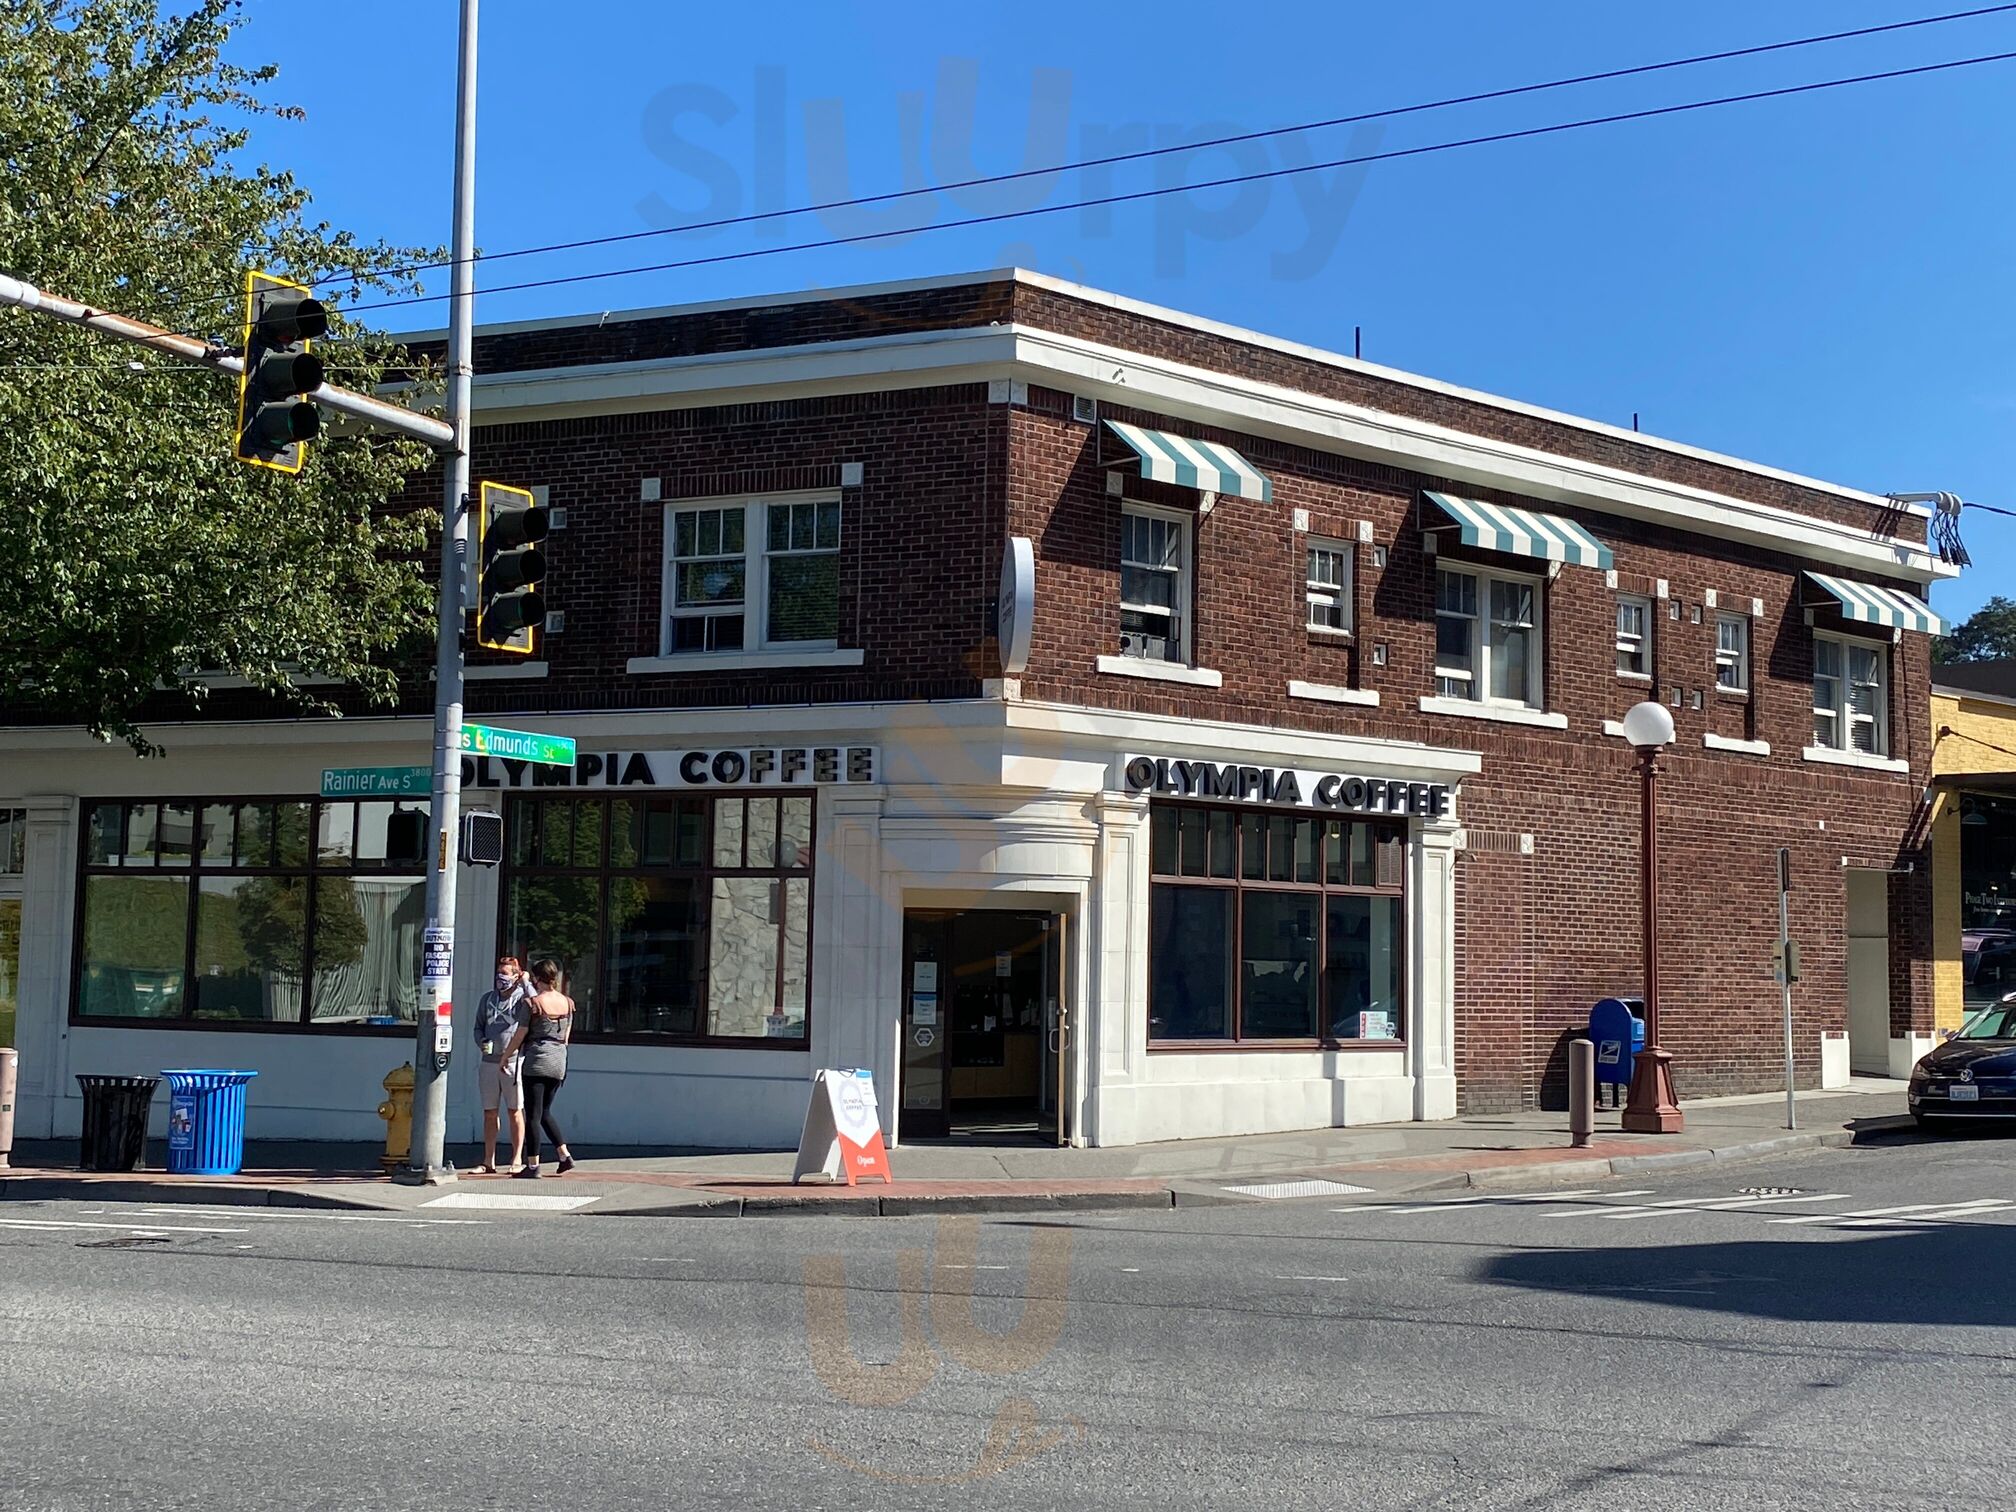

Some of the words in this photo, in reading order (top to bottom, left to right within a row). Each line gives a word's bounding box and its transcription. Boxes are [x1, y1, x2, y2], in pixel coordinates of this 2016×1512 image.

[475, 729, 538, 756] Edmunds
[543, 744, 555, 759] St
[679, 748, 872, 785] COFFEE
[323, 770, 376, 791] Rainier
[377, 775, 400, 789] Ave
[402, 775, 411, 789] S
[1126, 756, 1303, 803] OLYMPIA
[1313, 775, 1449, 815] COFFEE
[433, 943, 445, 951] NO
[426, 959, 450, 967] POLICE
[427, 967, 449, 975] STATE
